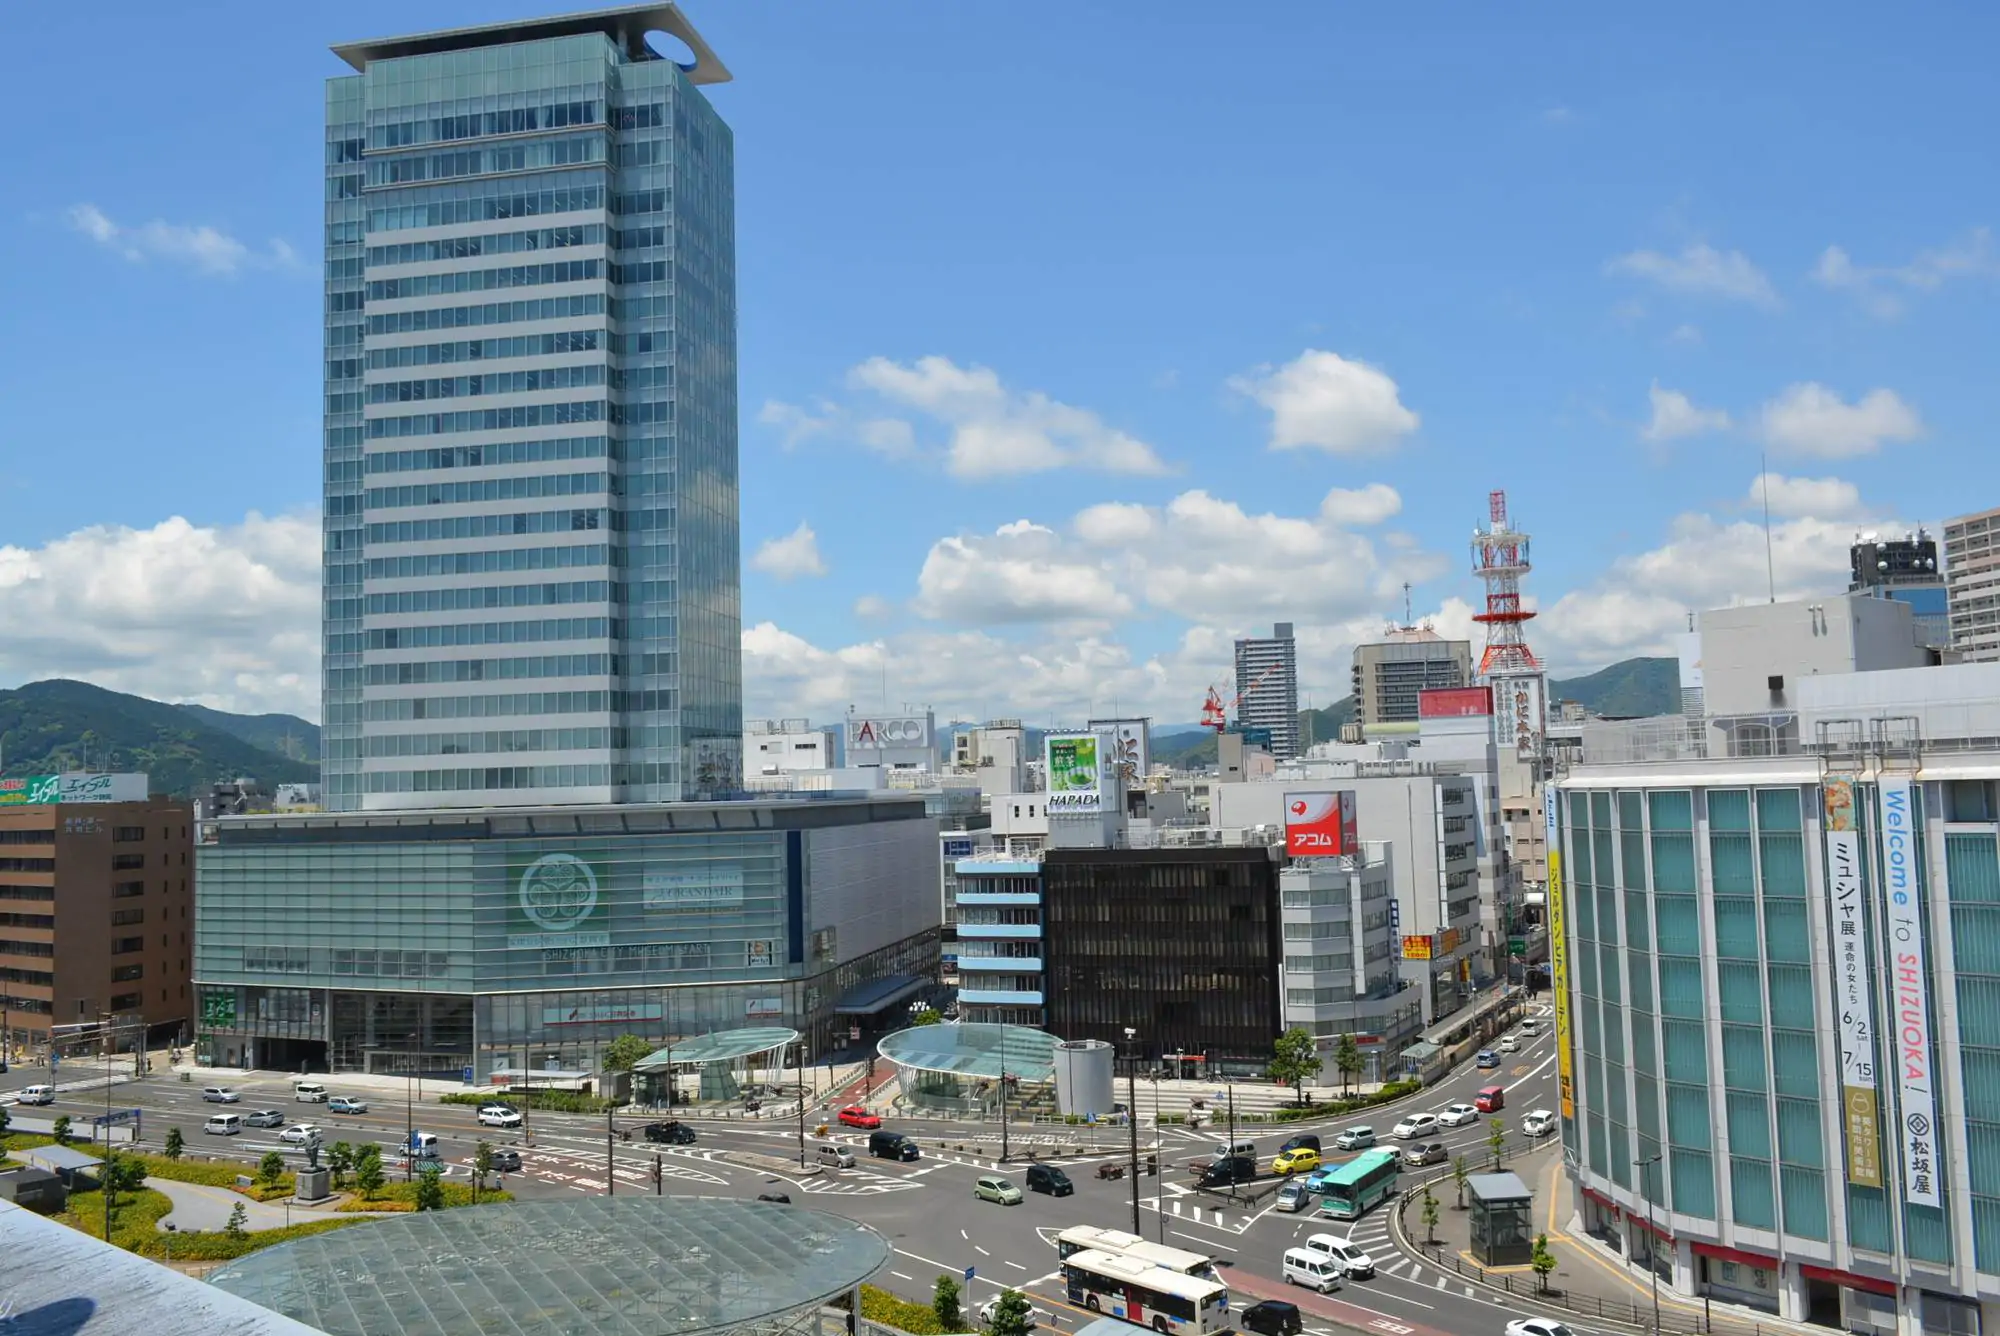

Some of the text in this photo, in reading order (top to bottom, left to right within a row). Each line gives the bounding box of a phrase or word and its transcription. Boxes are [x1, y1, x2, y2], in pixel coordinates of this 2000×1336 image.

[850, 720, 922, 742] PARCO
[27, 774, 60, 803] エイブル
[61, 774, 112, 793] エイブル
[1049, 794, 1100, 806] HARADA
[1294, 833, 1332, 846] アコム
[1886, 790, 1908, 906] Welcome
[1836, 842, 1856, 936] ミュシャ展
[1895, 918, 1914, 942] to
[1844, 941, 1858, 1005] 運命の女たち
[1910, 1137, 1932, 1195] 松坂屋
